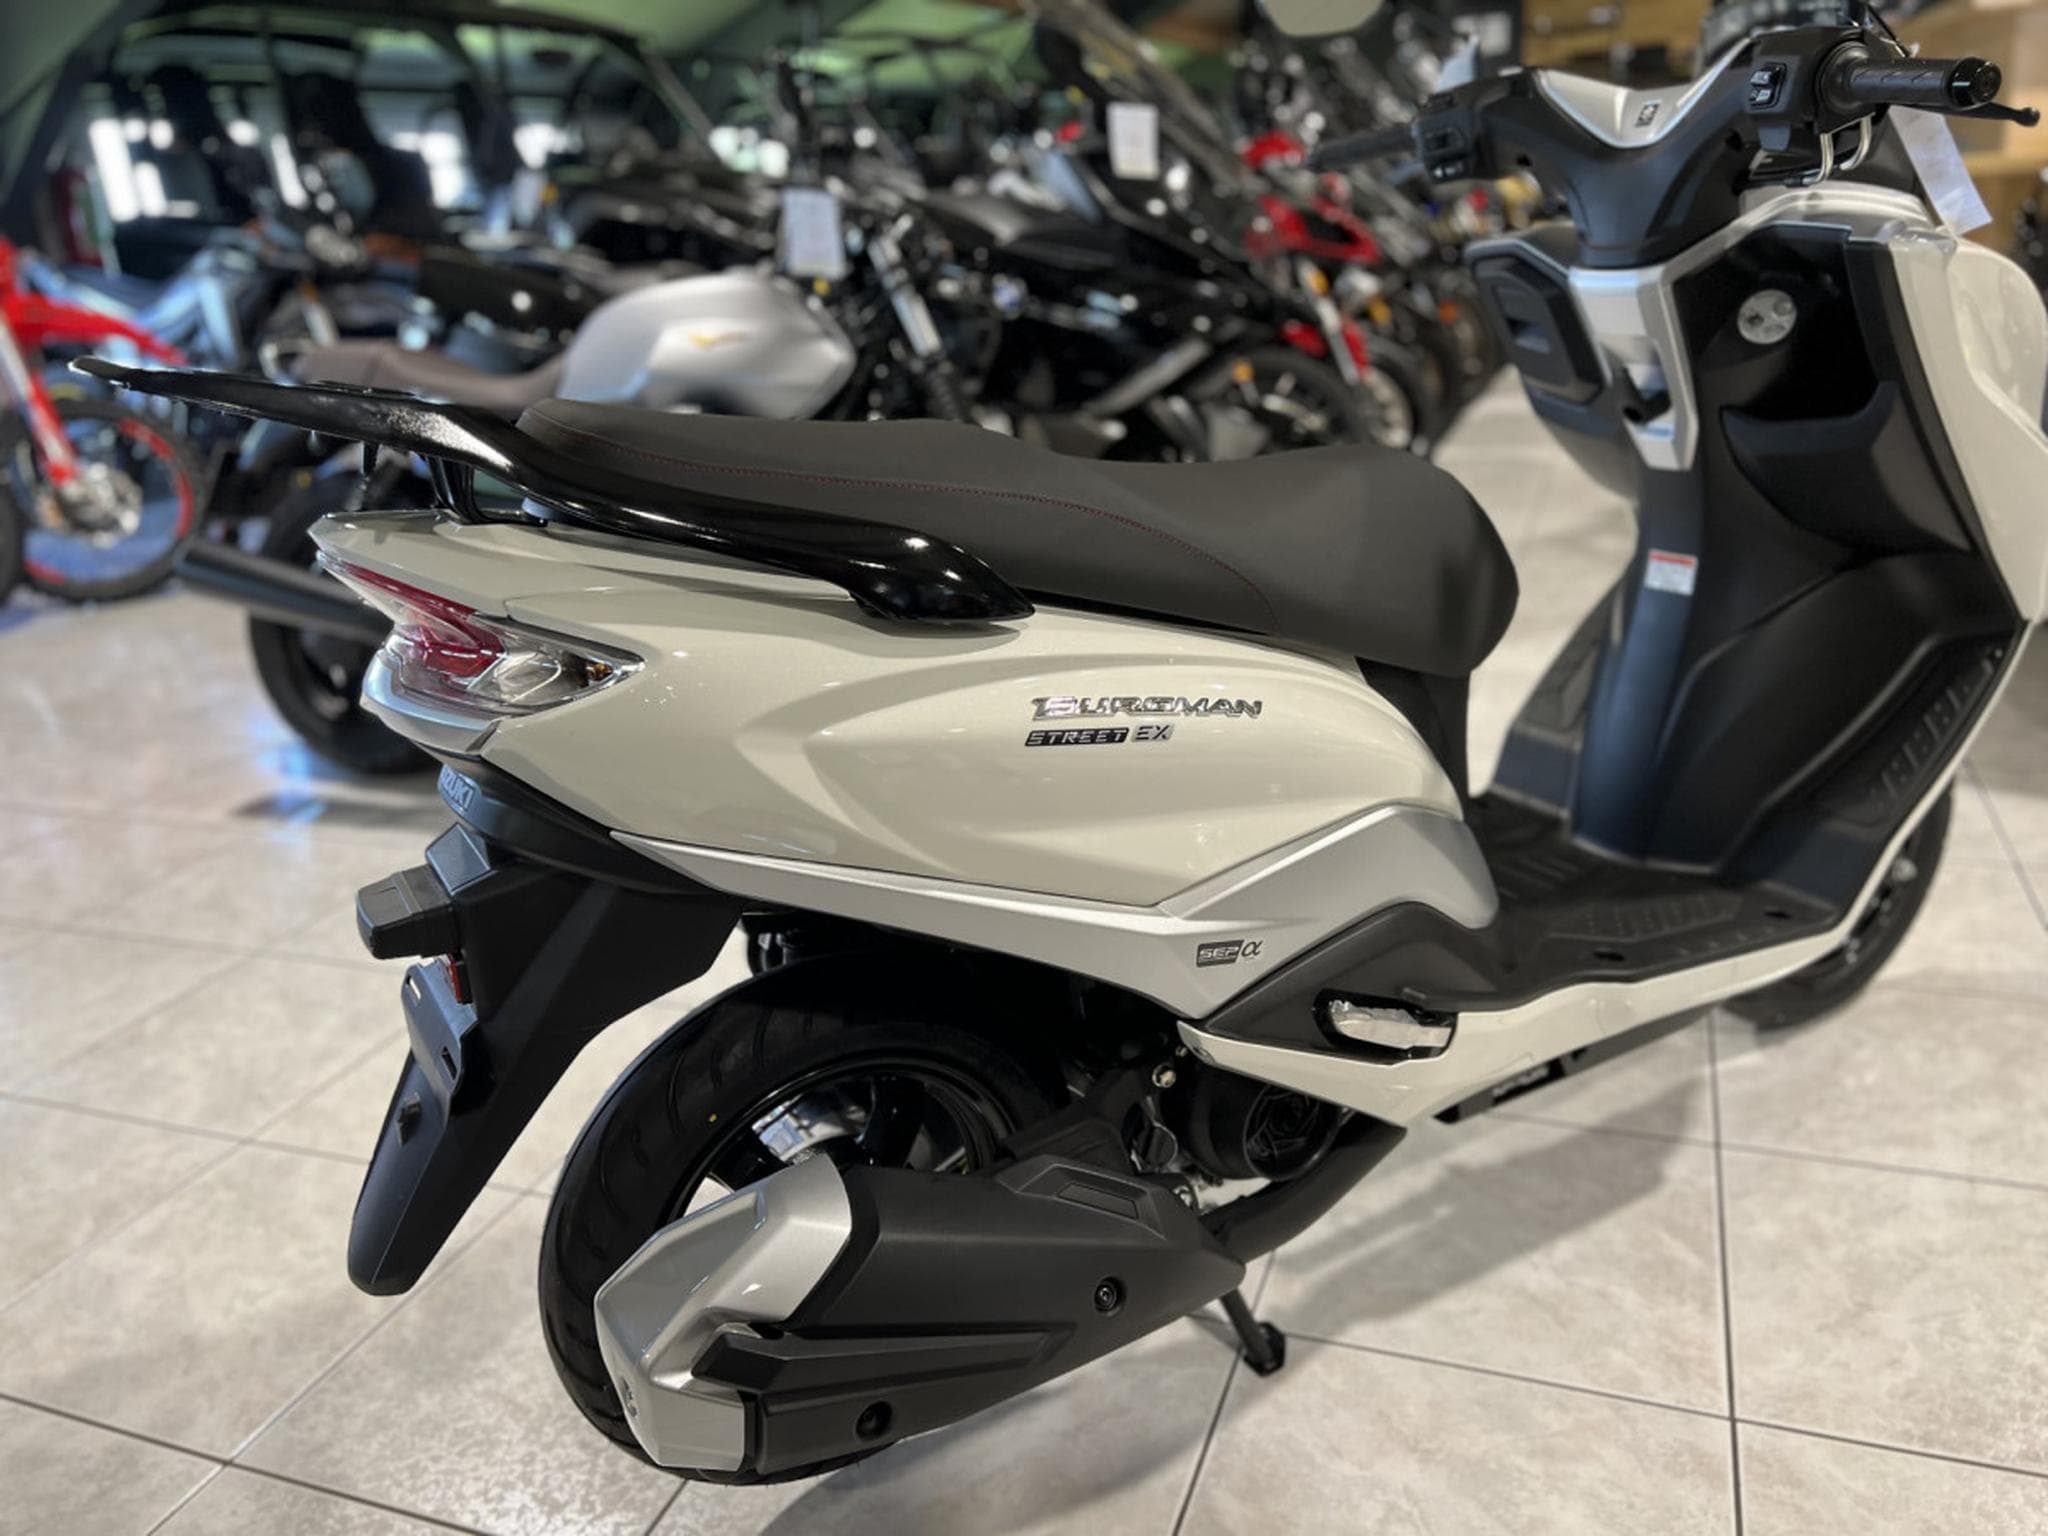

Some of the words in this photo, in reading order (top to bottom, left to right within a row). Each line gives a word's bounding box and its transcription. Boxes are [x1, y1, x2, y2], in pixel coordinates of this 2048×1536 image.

[1031, 695, 1263, 721] BURGMAN
[1026, 727, 1128, 745] STREET
[1135, 724, 1172, 741] EX
[1198, 944, 1241, 963] SEP
